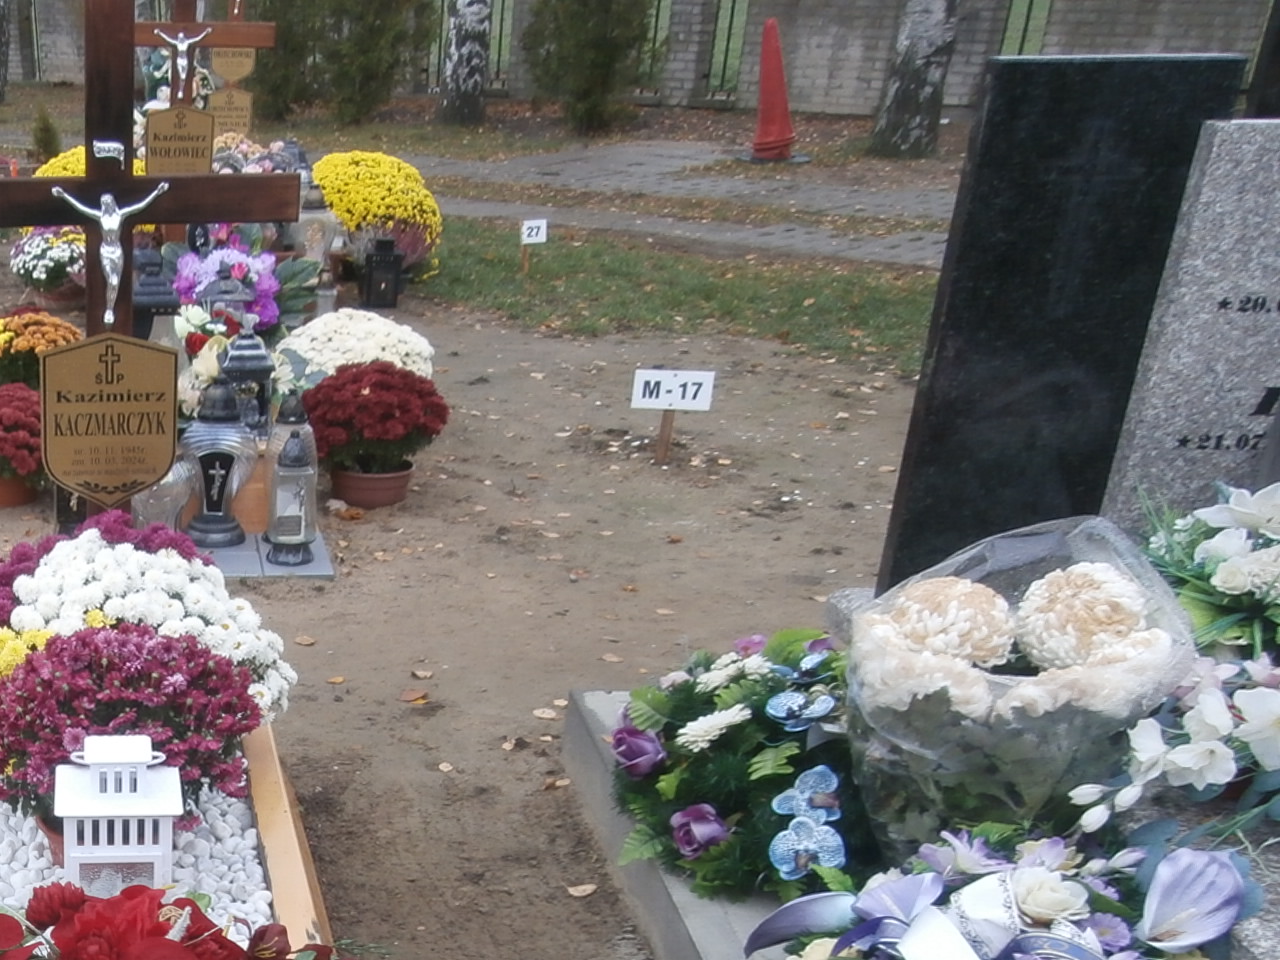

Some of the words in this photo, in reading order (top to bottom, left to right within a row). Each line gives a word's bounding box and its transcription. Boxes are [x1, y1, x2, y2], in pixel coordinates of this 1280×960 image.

[153, 132, 207, 142] Kazimierz
[149, 146, 210, 159] WOŁOWIEC
[526, 225, 542, 238] 27
[56, 388, 167, 404] Kazimierz
[53, 411, 167, 437] KACZMARCZYK
